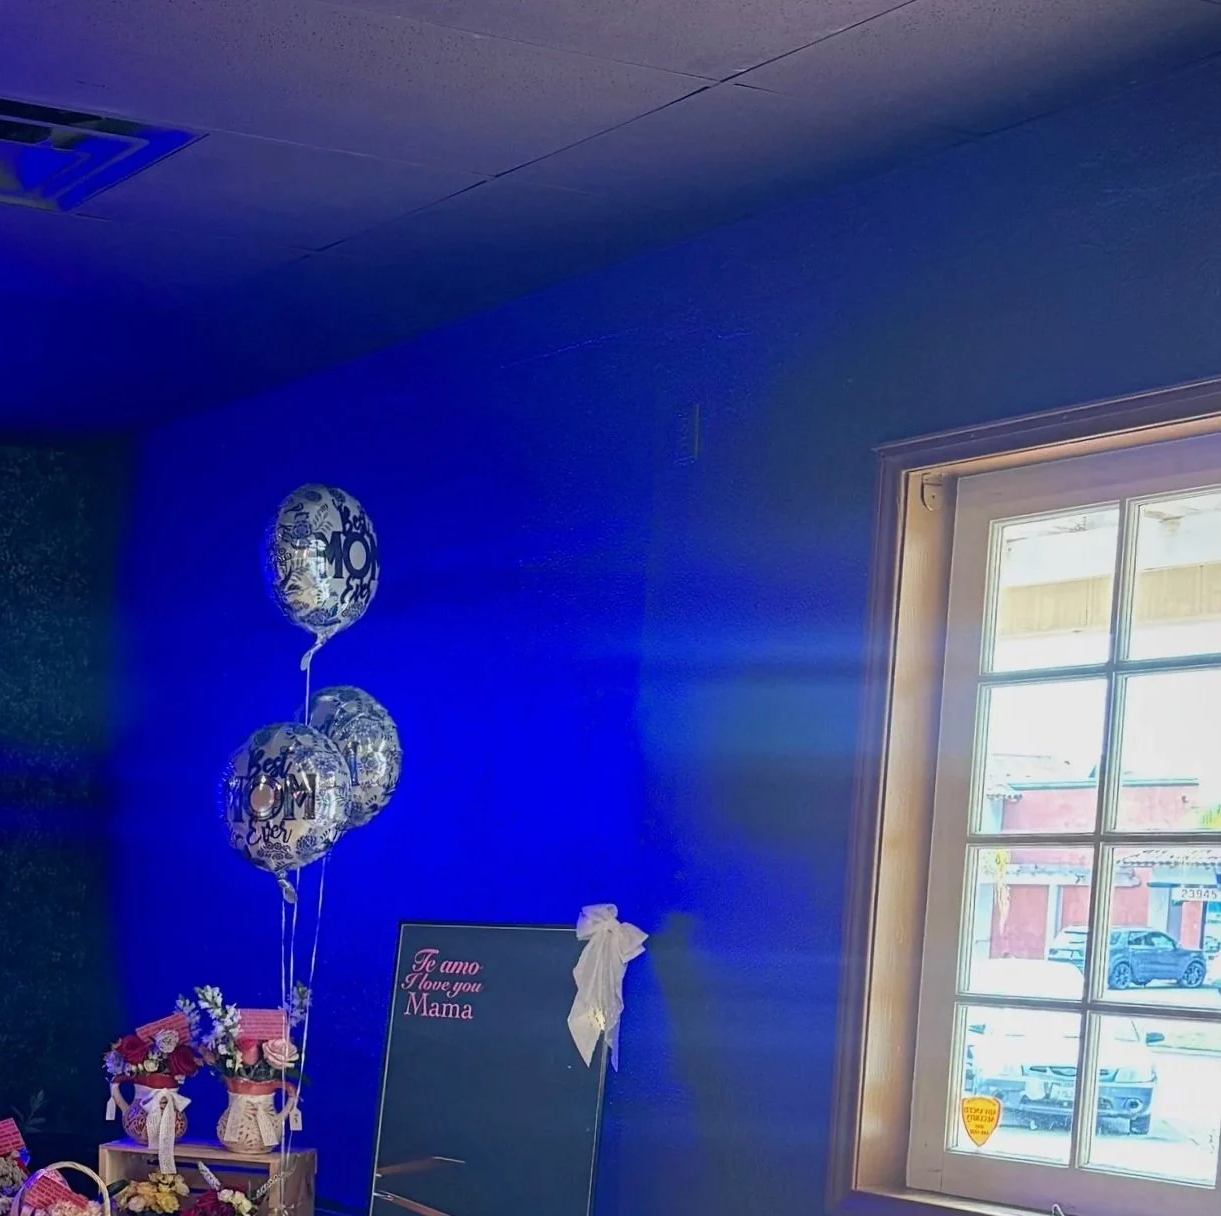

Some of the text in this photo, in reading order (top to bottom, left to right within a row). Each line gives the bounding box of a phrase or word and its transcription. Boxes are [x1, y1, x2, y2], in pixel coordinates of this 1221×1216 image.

[412, 948, 483, 976] Te amo
[401, 972, 484, 998] I love you
[403, 991, 474, 1020] Mama
